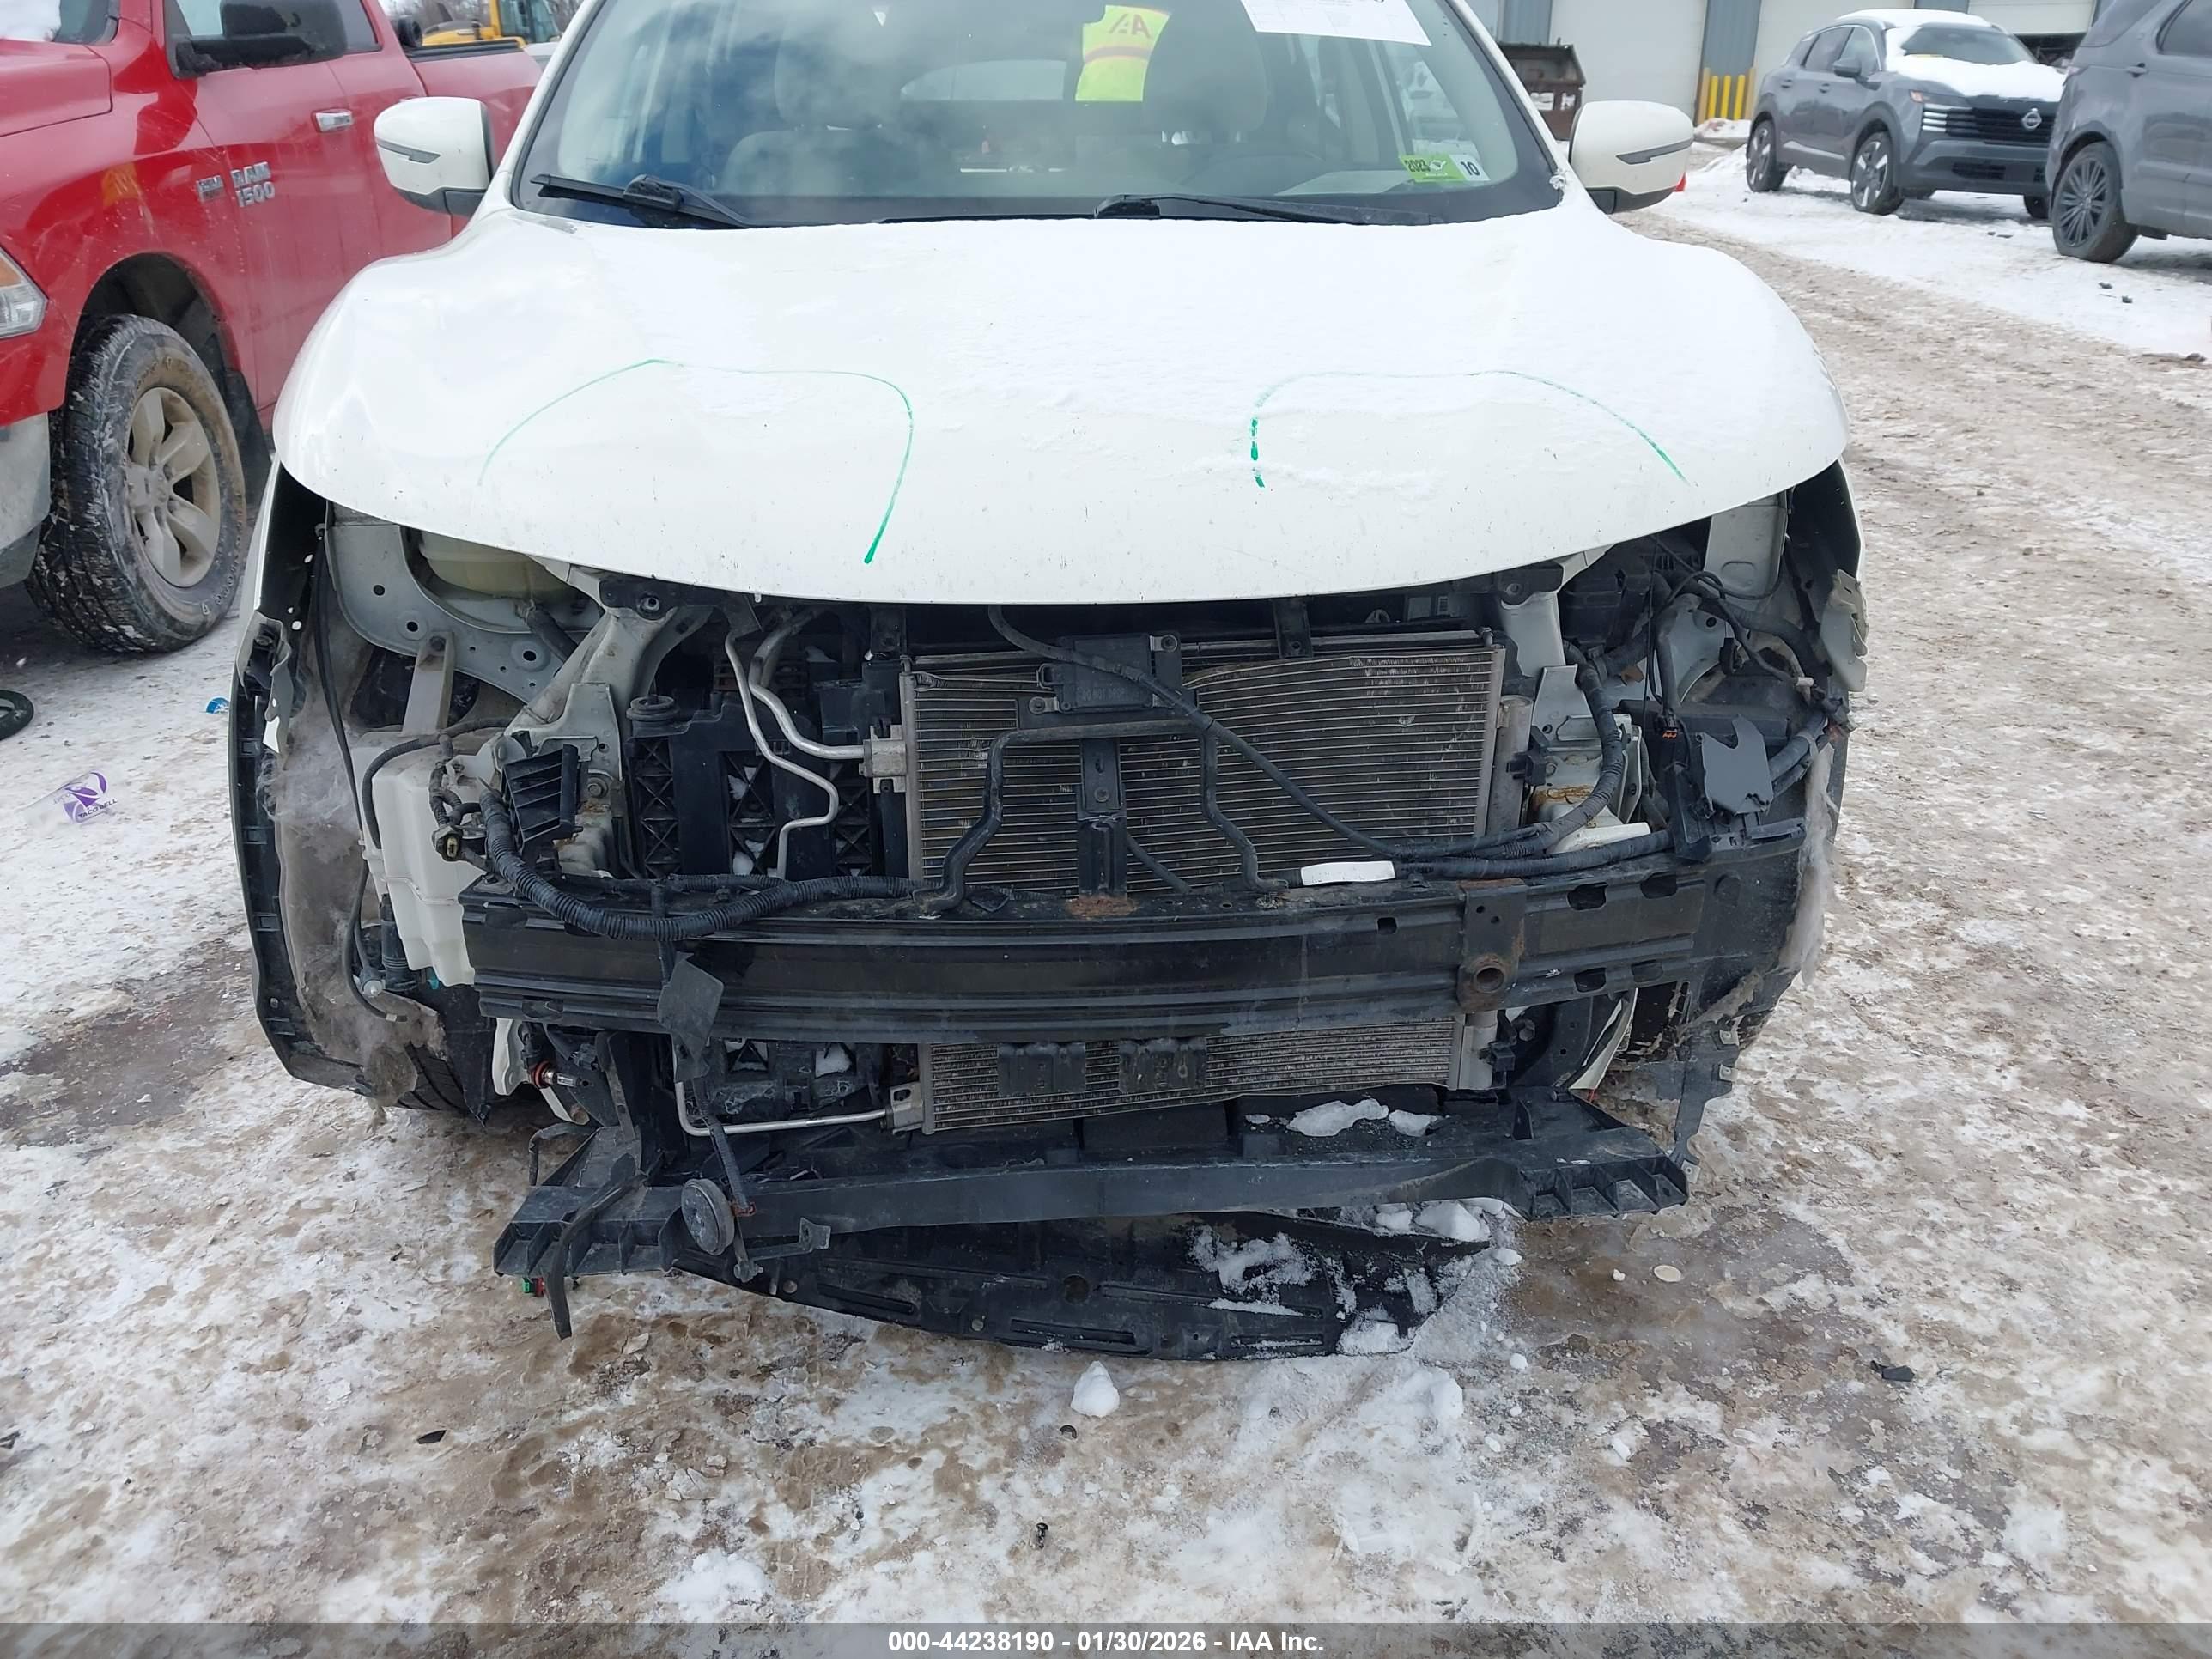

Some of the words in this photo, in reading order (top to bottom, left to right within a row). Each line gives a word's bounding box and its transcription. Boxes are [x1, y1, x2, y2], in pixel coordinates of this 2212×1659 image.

[230, 161, 271, 189] RAM
[1460, 161, 1480, 176] 10
[235, 181, 276, 208] 1500
[78, 806, 99, 818] TACO
[100, 798, 118, 810] BELL
